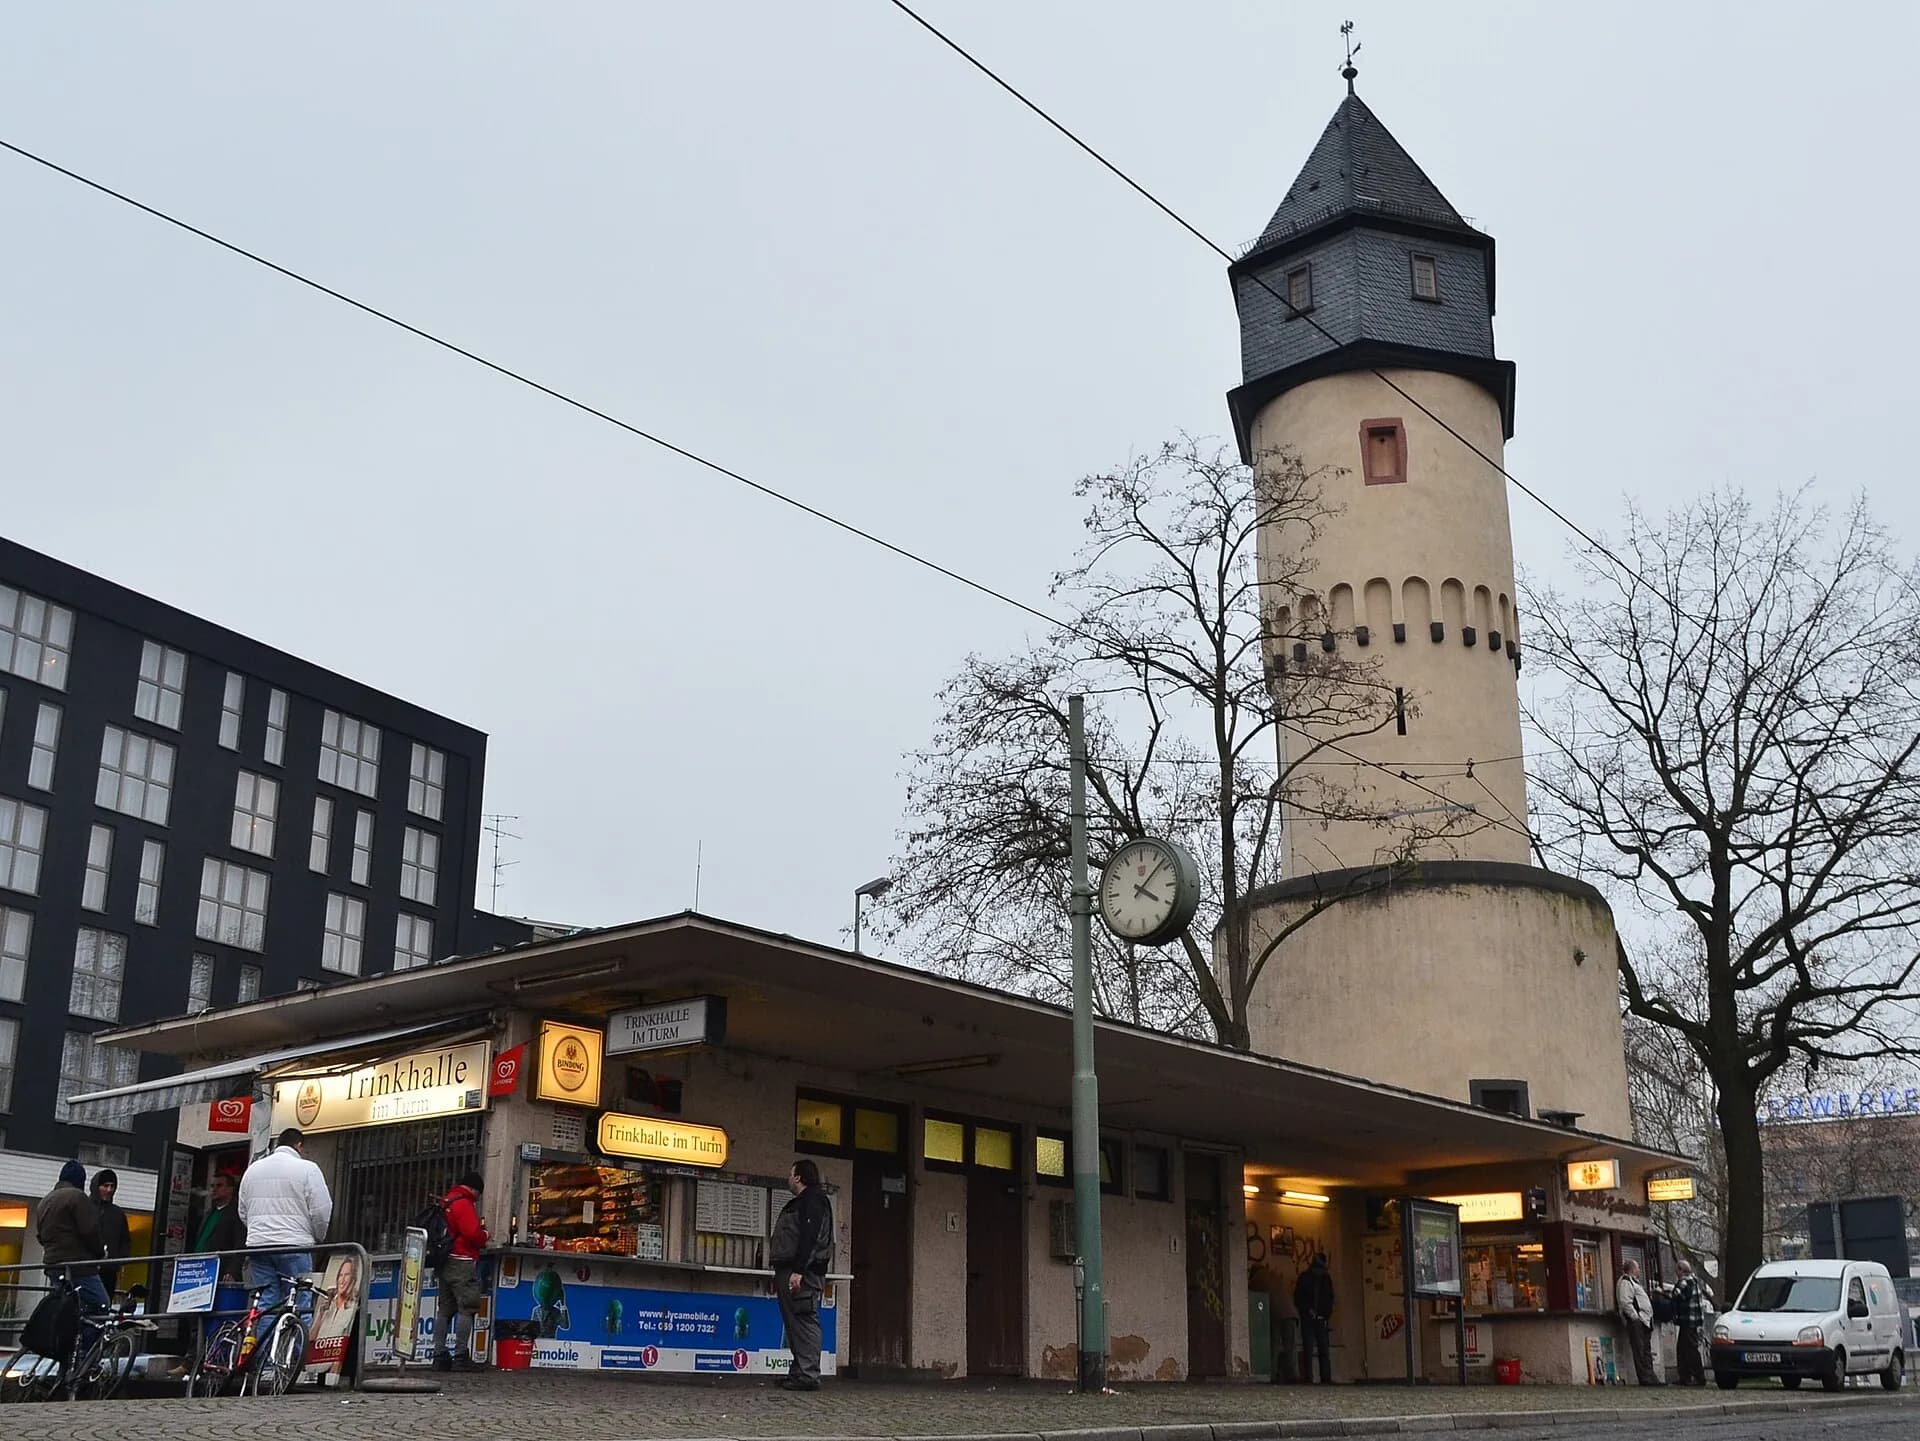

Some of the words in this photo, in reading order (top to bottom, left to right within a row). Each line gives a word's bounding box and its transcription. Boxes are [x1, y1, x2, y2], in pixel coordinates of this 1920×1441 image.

[624, 1008, 689, 1029] TRINKHALLE
[632, 1031, 645, 1045] IM
[647, 1026, 679, 1042] TURM
[347, 1054, 467, 1101] Trinkhalle
[372, 1101, 388, 1120] im
[394, 1097, 430, 1117] Turm
[608, 1124, 669, 1147] Trinkhalle
[673, 1132, 688, 1150] im
[692, 1136, 722, 1154] Turm
[676, 1322, 696, 1333] 1200
[315, 1336, 344, 1350] COFFEE
[532, 1348, 579, 1362] amobile
